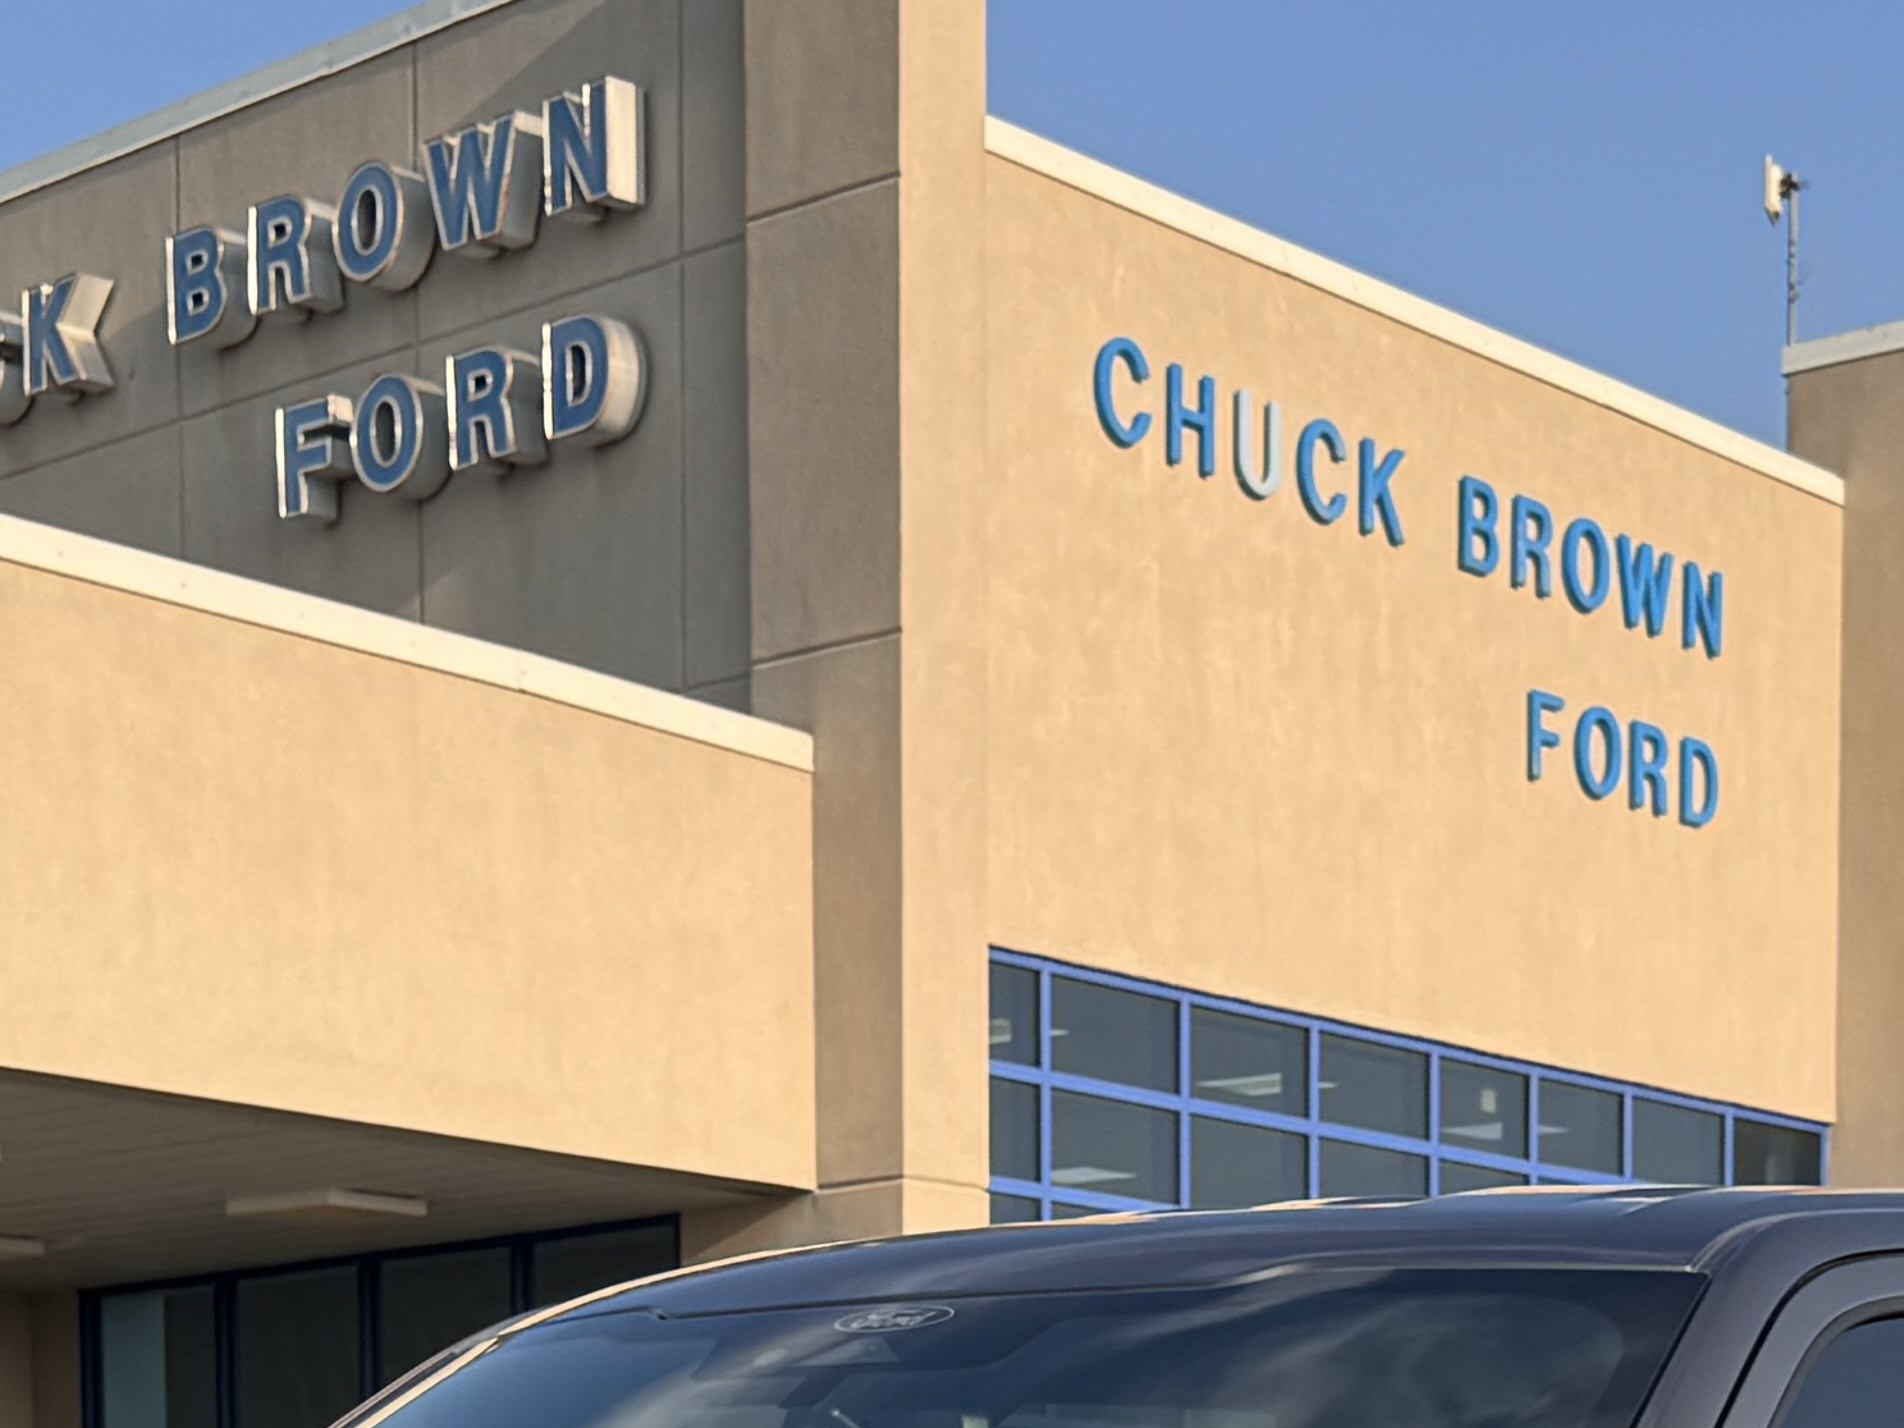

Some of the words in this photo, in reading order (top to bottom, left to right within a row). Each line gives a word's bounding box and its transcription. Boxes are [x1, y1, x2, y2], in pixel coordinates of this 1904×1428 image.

[165, 75, 646, 349] BROWN
[275, 313, 648, 522] FORD
[1093, 337, 1406, 547] CHUCK
[1457, 474, 1724, 659] BROWN
[1527, 689, 1721, 829] FORD
